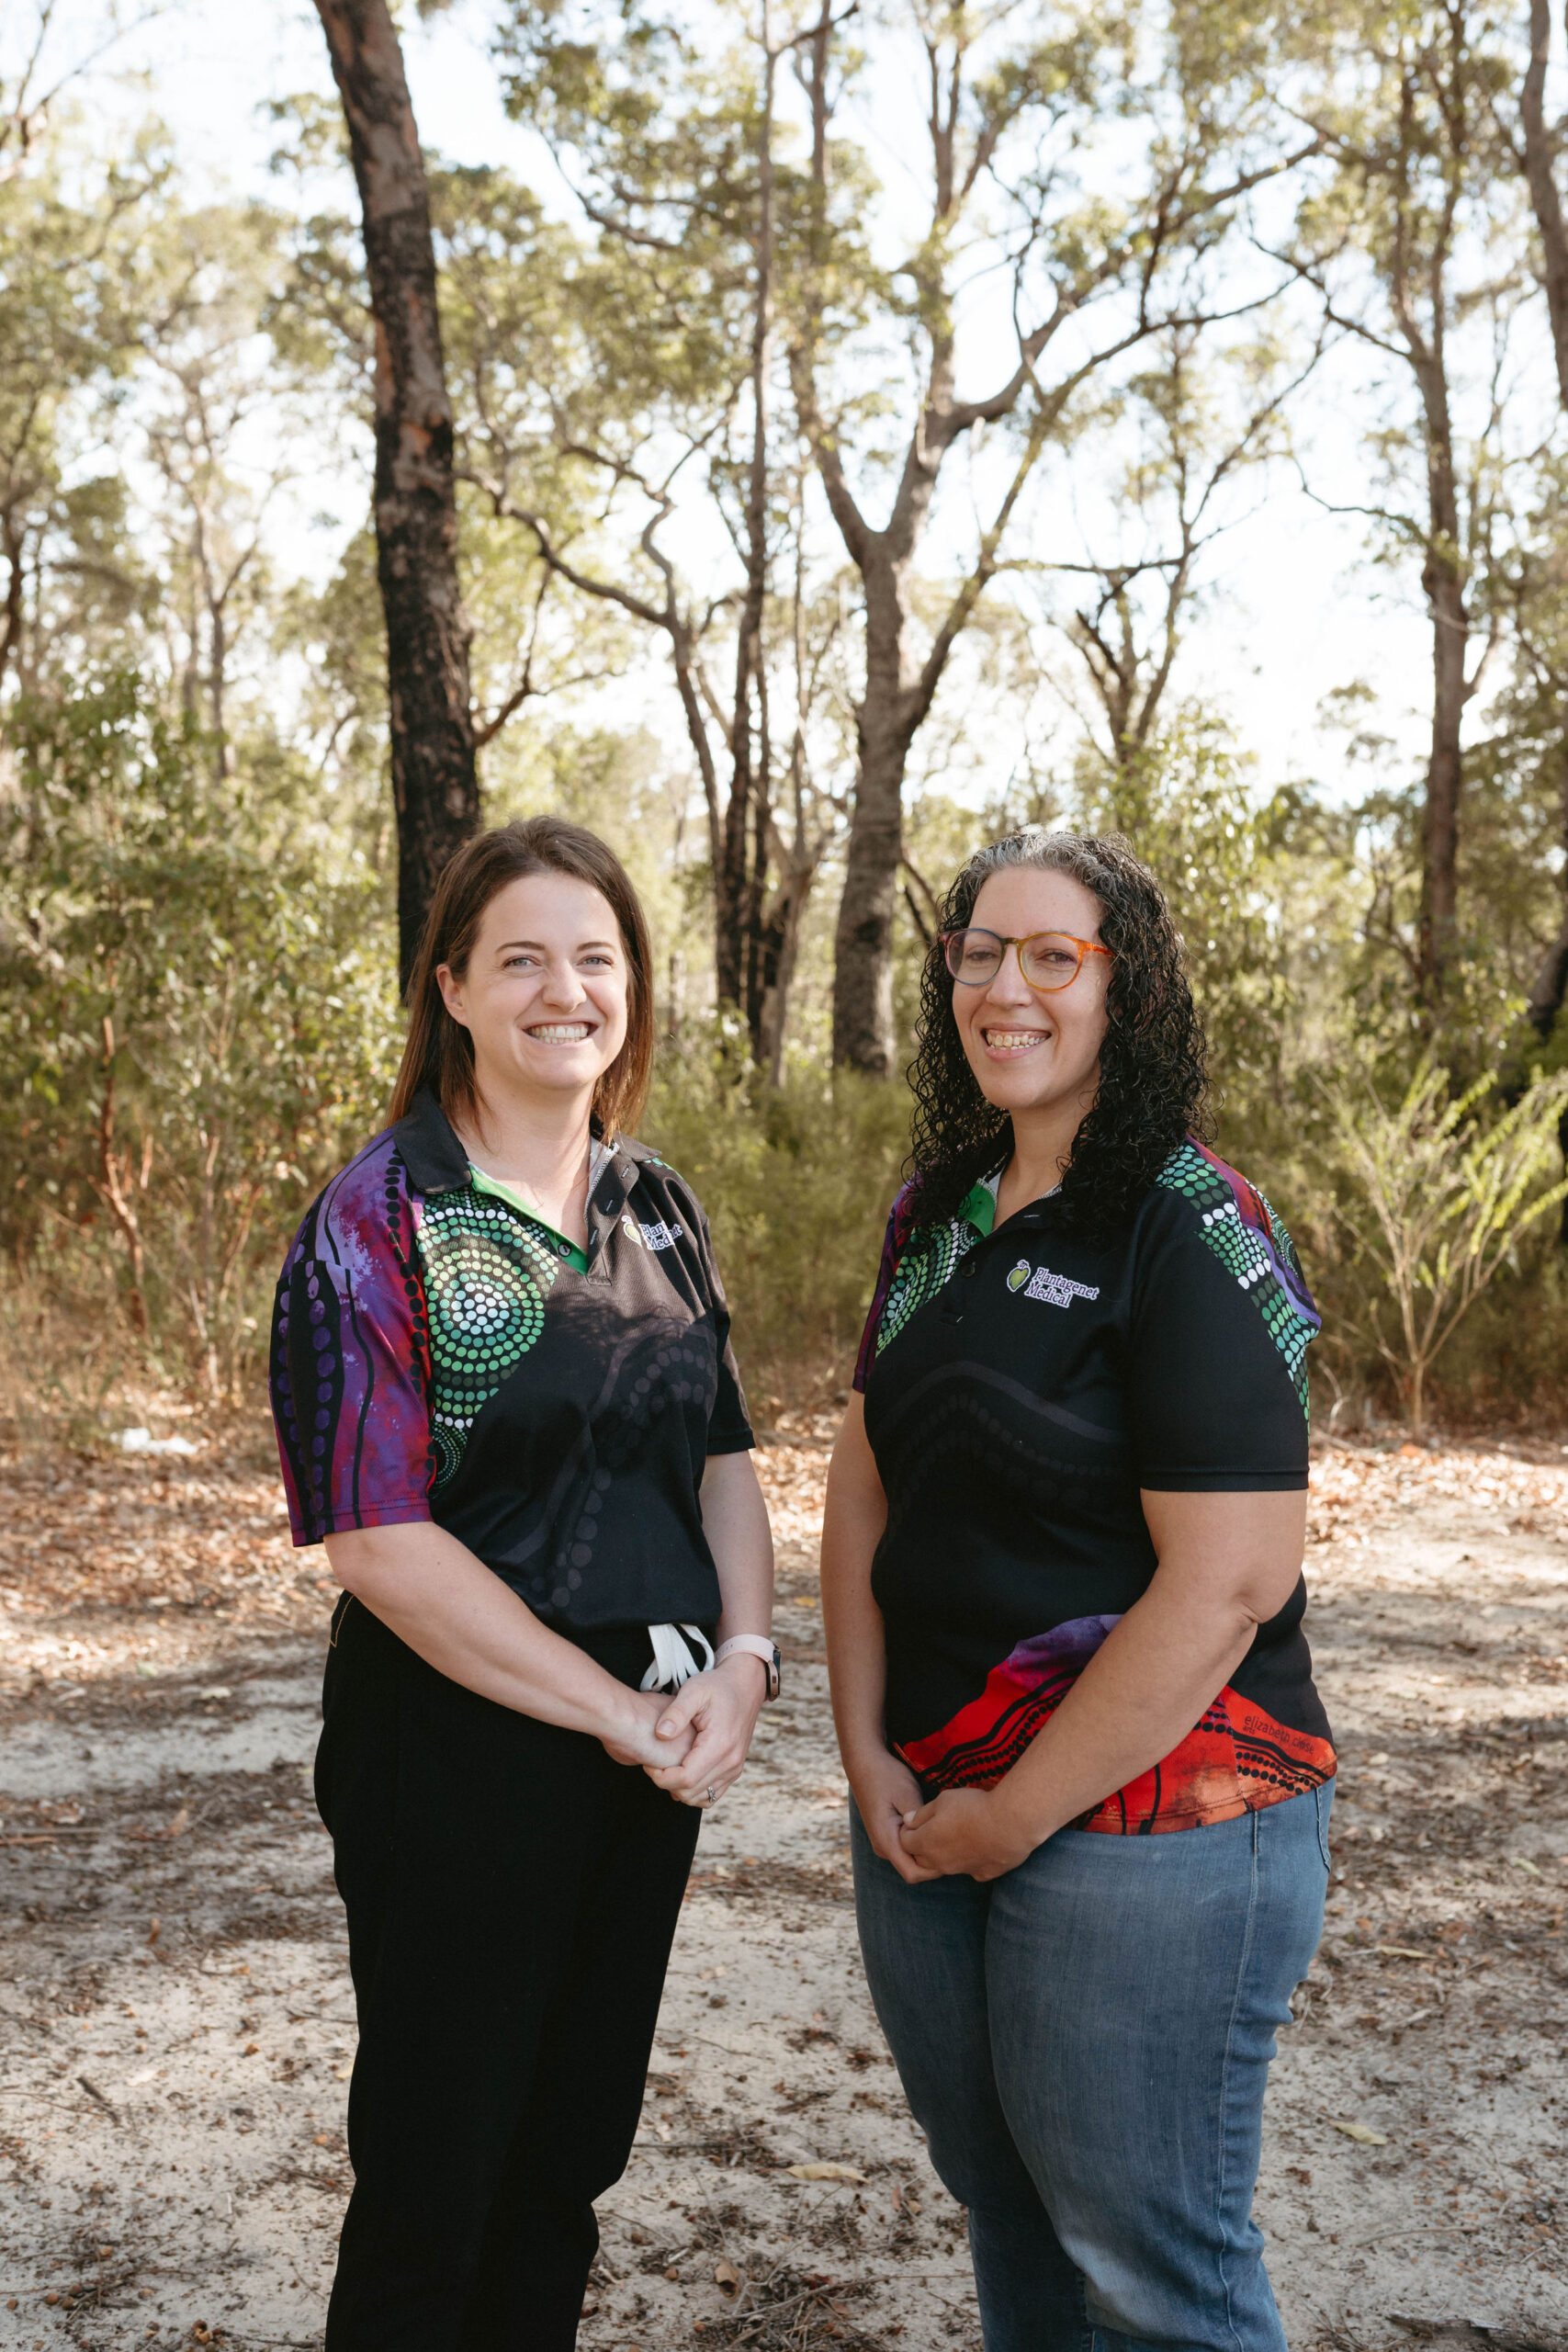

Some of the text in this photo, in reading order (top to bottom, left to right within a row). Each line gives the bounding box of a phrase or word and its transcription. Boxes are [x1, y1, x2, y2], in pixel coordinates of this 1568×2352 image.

[1025, 1283, 1073, 1306] Medical
[1033, 1268, 1099, 1299] Plantagenet
[1244, 1715, 1291, 1743] elizabeth
